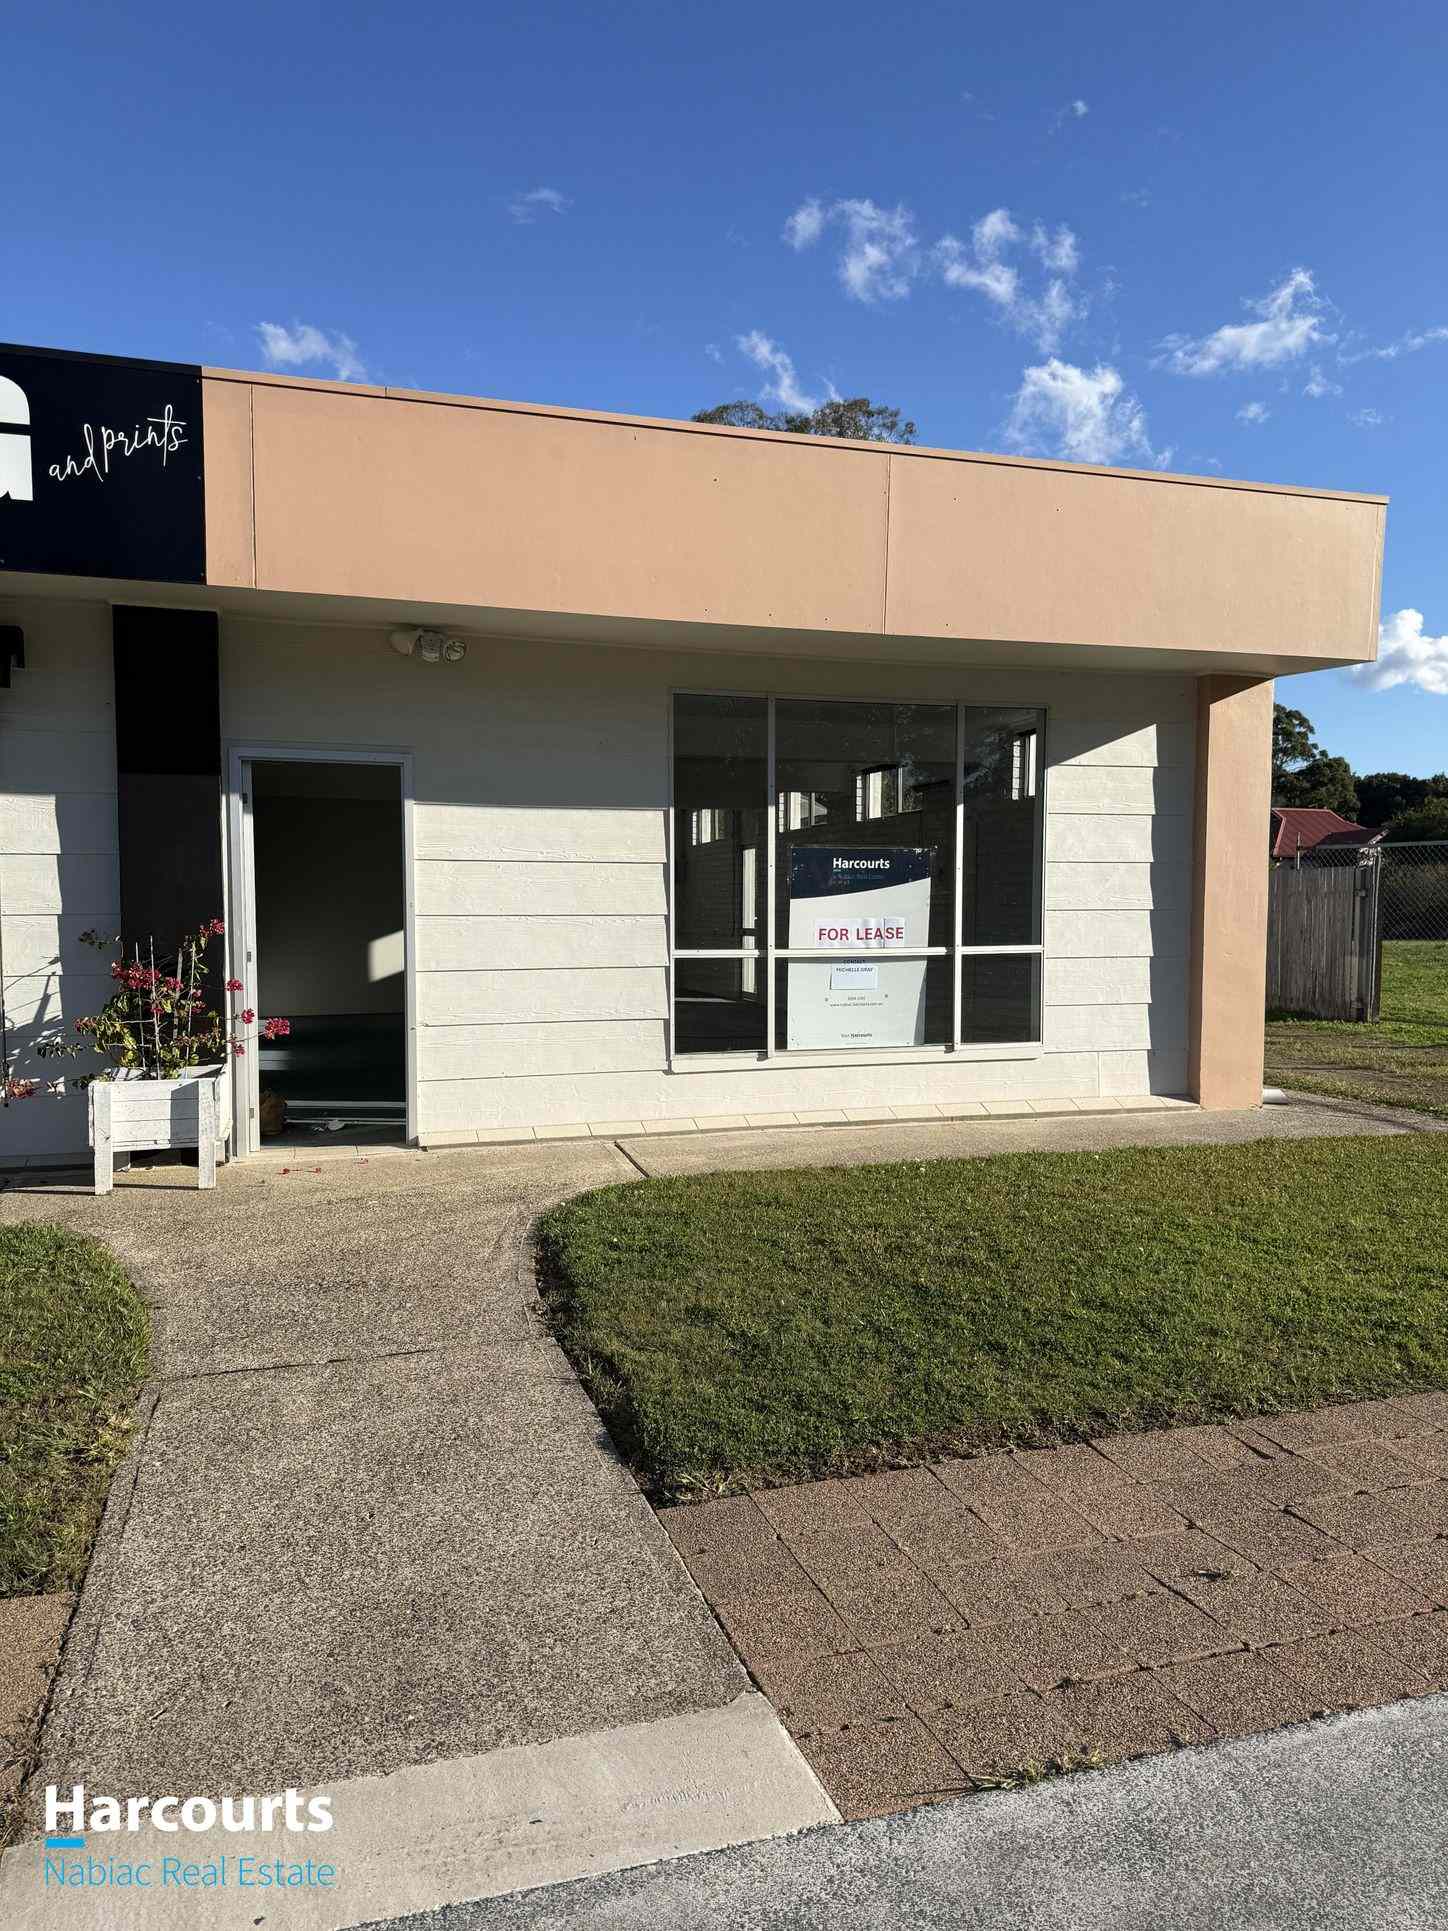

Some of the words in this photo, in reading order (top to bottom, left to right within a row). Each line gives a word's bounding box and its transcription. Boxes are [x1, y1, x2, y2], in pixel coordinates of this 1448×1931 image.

[48, 423, 104, 482] and
[101, 404, 189, 473] prints
[832, 857, 890, 869] Harcourts
[818, 927, 849, 941] FOR
[856, 926, 905, 941] LEASE
